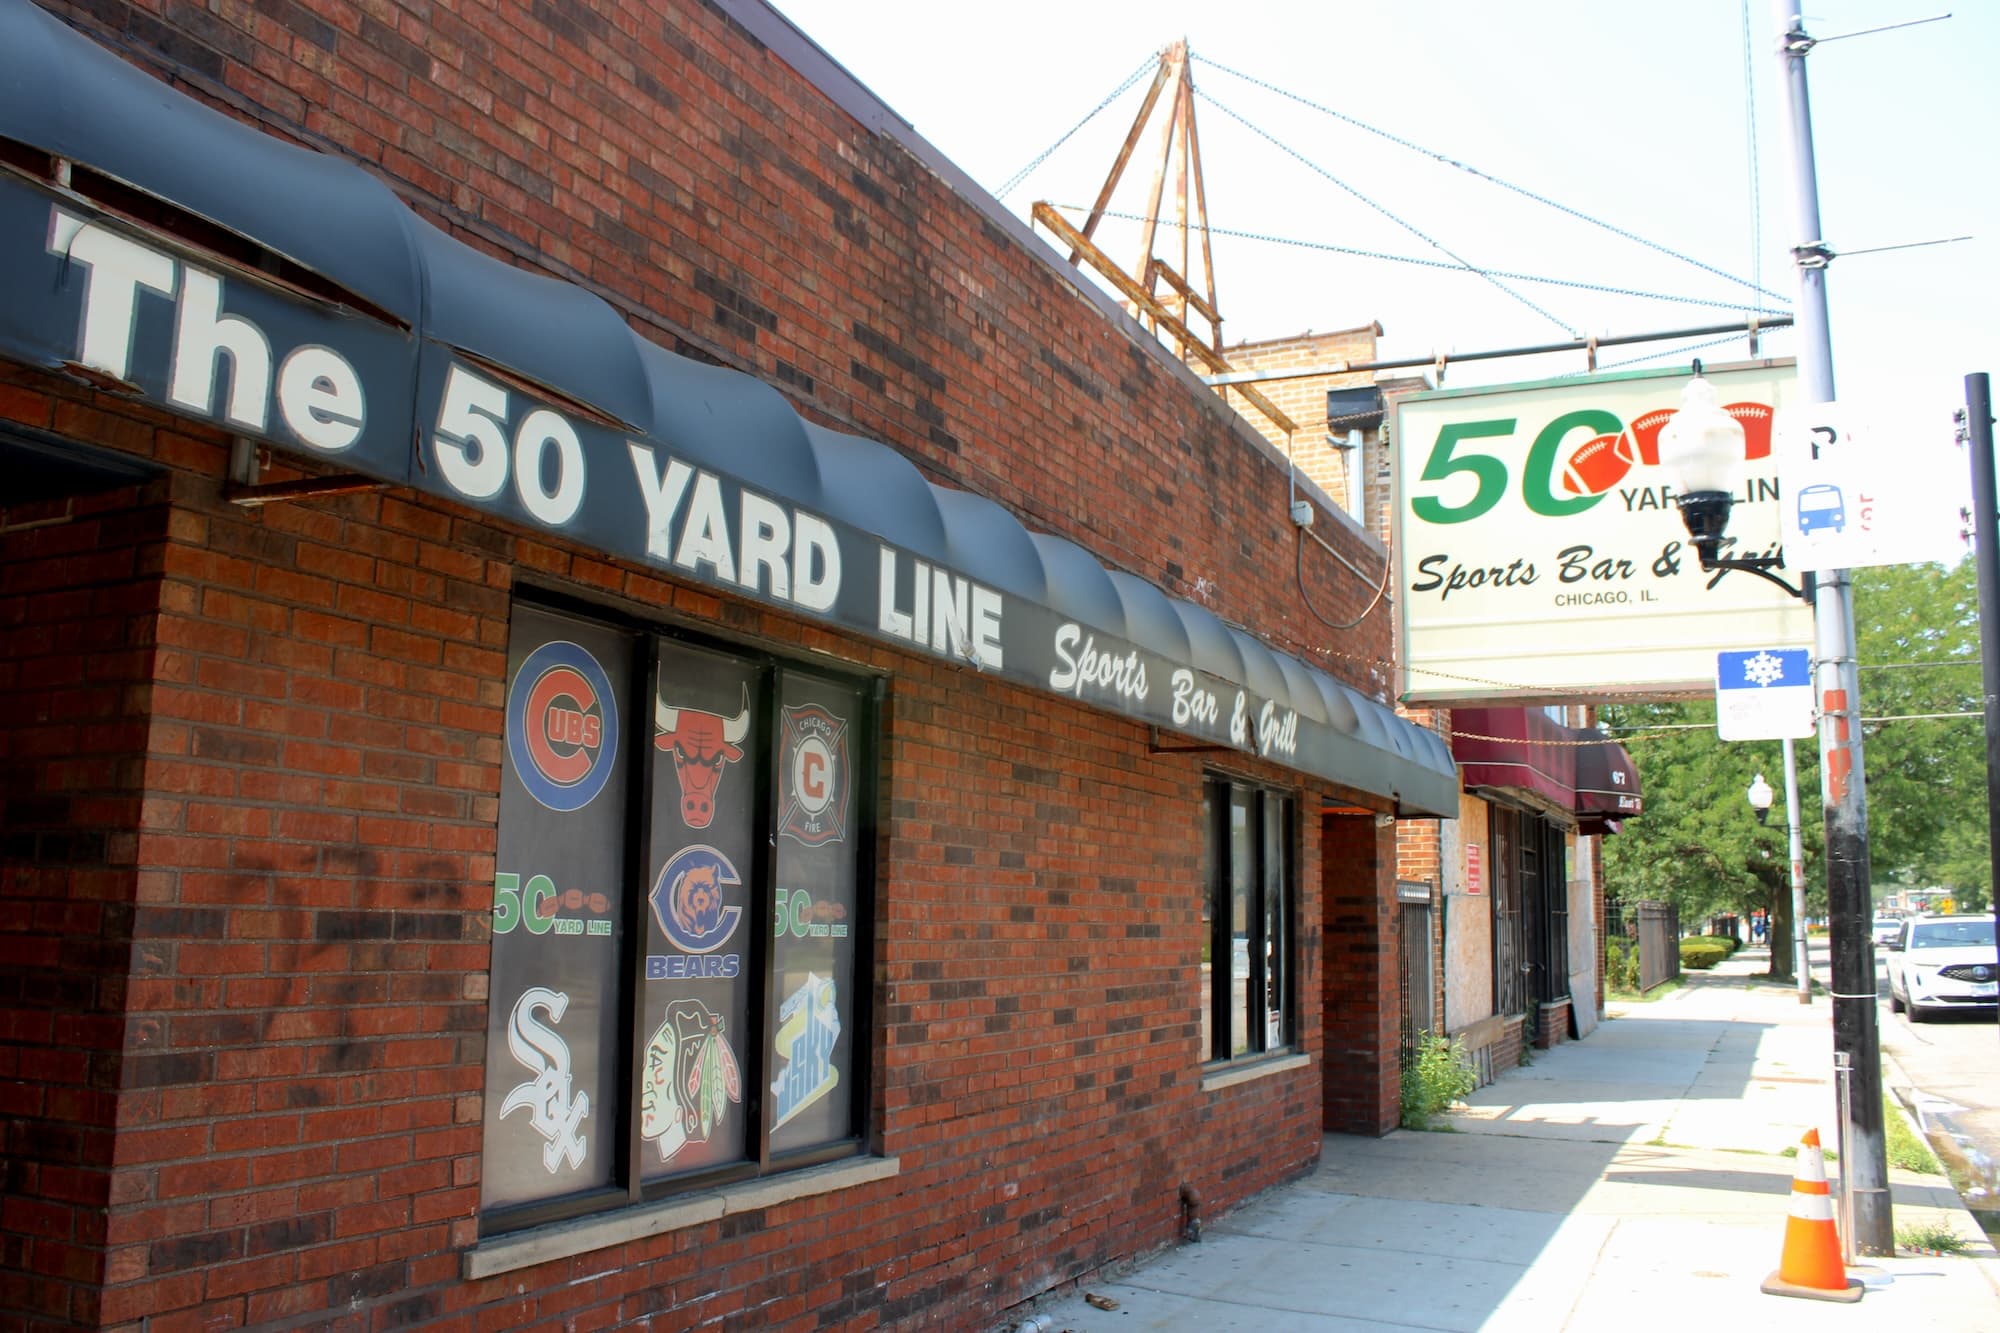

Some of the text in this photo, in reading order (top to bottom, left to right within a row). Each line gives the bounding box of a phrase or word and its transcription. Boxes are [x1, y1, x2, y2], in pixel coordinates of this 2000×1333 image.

[47, 205, 366, 451] The
[1410, 408, 1624, 525] 50
[432, 362, 1003, 671] 50 YARD LINE
[1619, 484, 1680, 512] YAR
[1411, 553, 1541, 602] Sports
[1556, 544, 1637, 584] Bar
[1652, 540, 1682, 578] &
[1554, 589, 1660, 607] CHICAGO, IL.
[1049, 623, 1298, 757] Sports Bar & Grill
[799, 717, 832, 737] CHICAGO
[803, 751, 825, 800] C
[804, 821, 821, 833] FIRE
[493, 872, 557, 935] 50
[553, 918, 612, 936] YARD LINE
[774, 888, 812, 938] 50
[645, 954, 740, 980] BEARS
